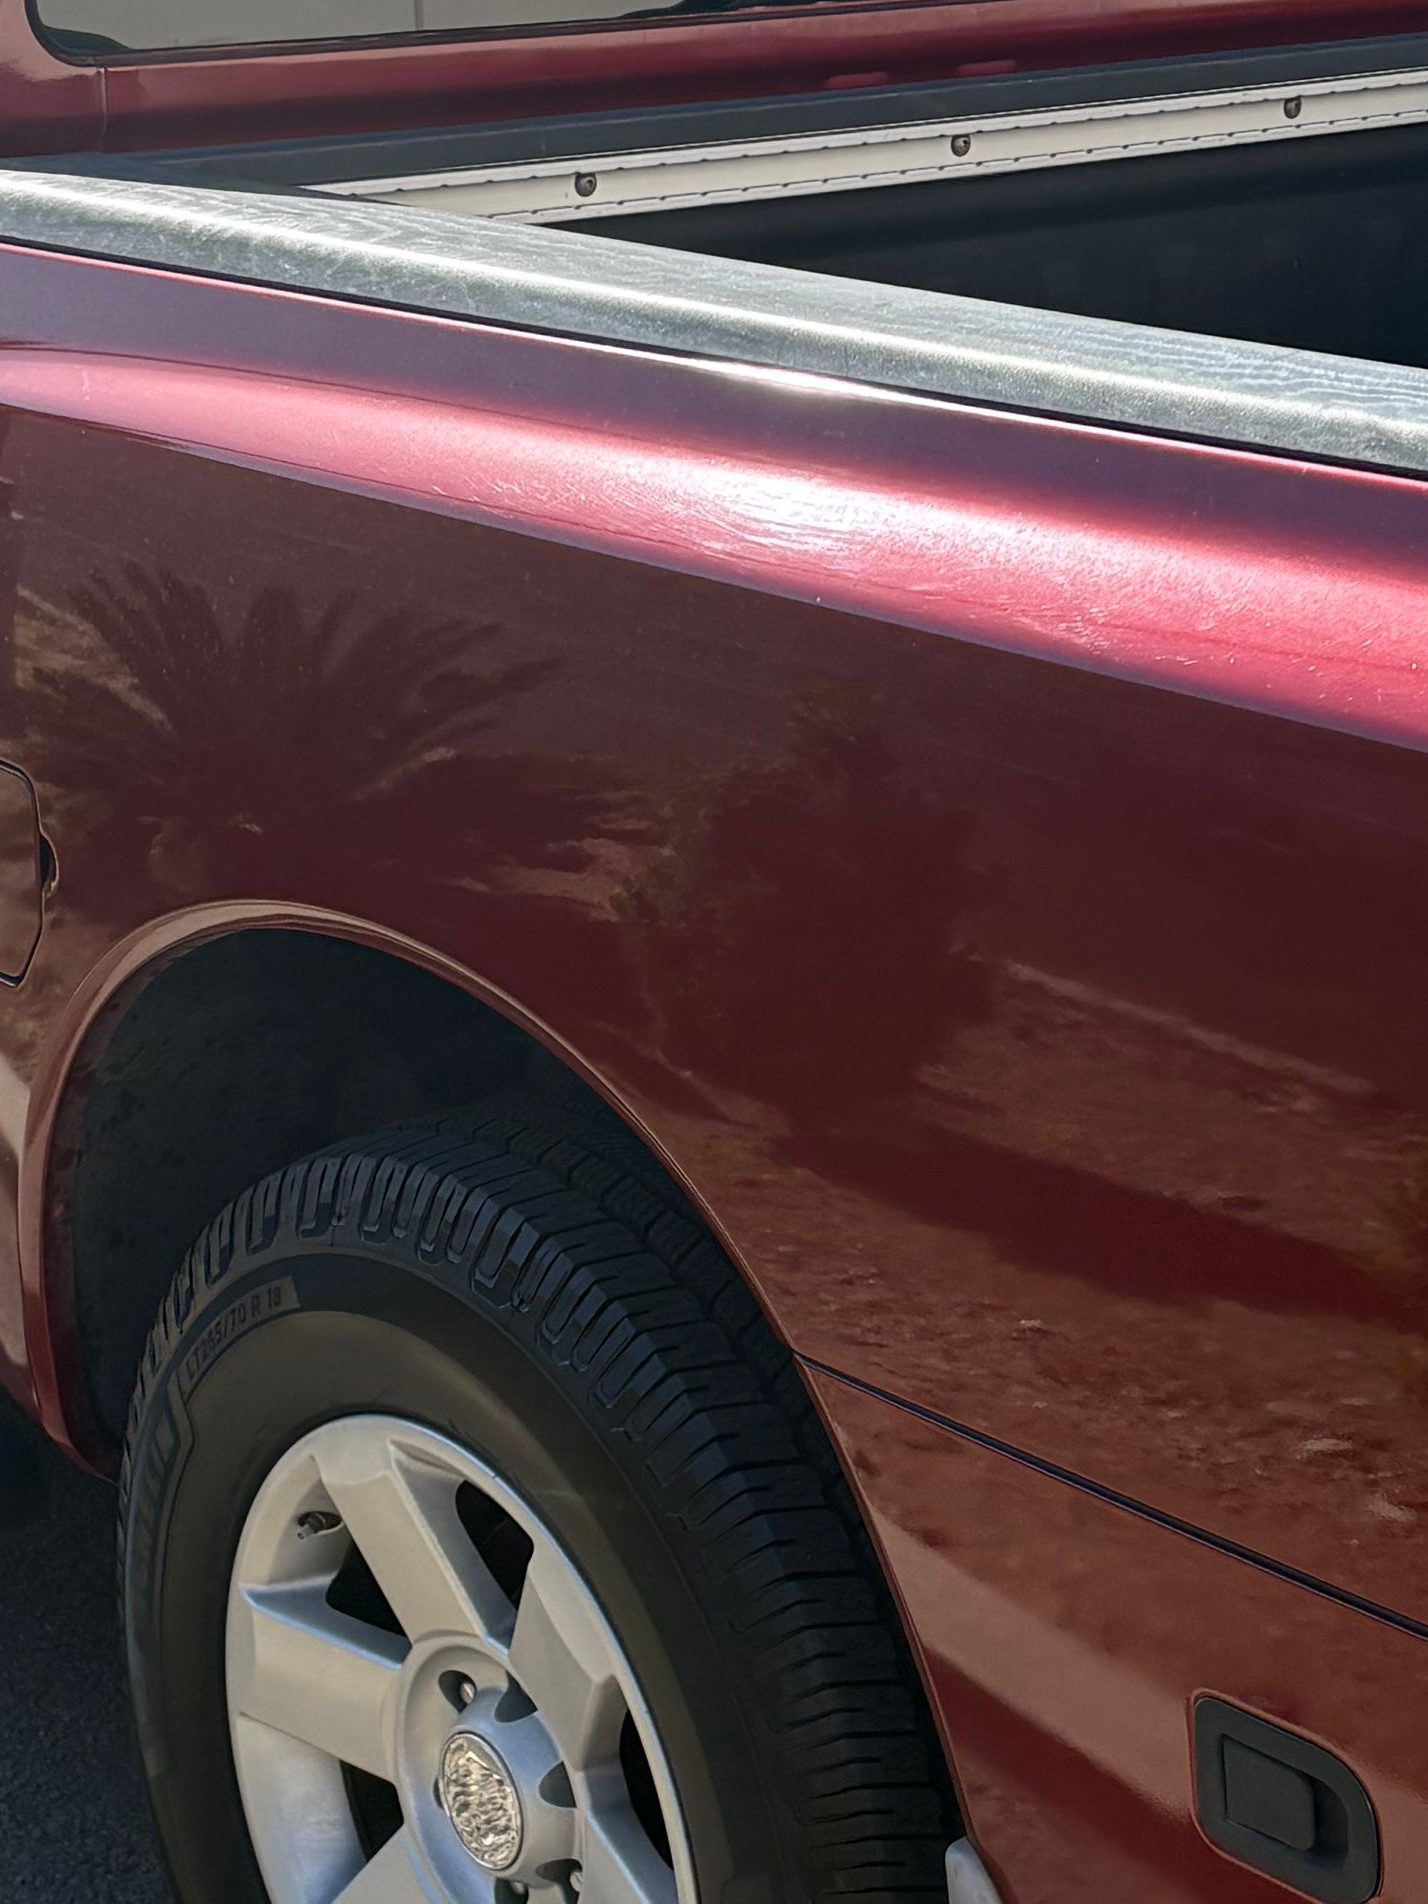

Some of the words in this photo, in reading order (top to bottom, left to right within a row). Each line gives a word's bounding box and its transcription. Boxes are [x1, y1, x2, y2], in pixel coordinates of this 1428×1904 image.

[185, 1302, 248, 1382] LT265/70
[250, 1296, 262, 1316] R
[268, 1285, 282, 1309] 18
